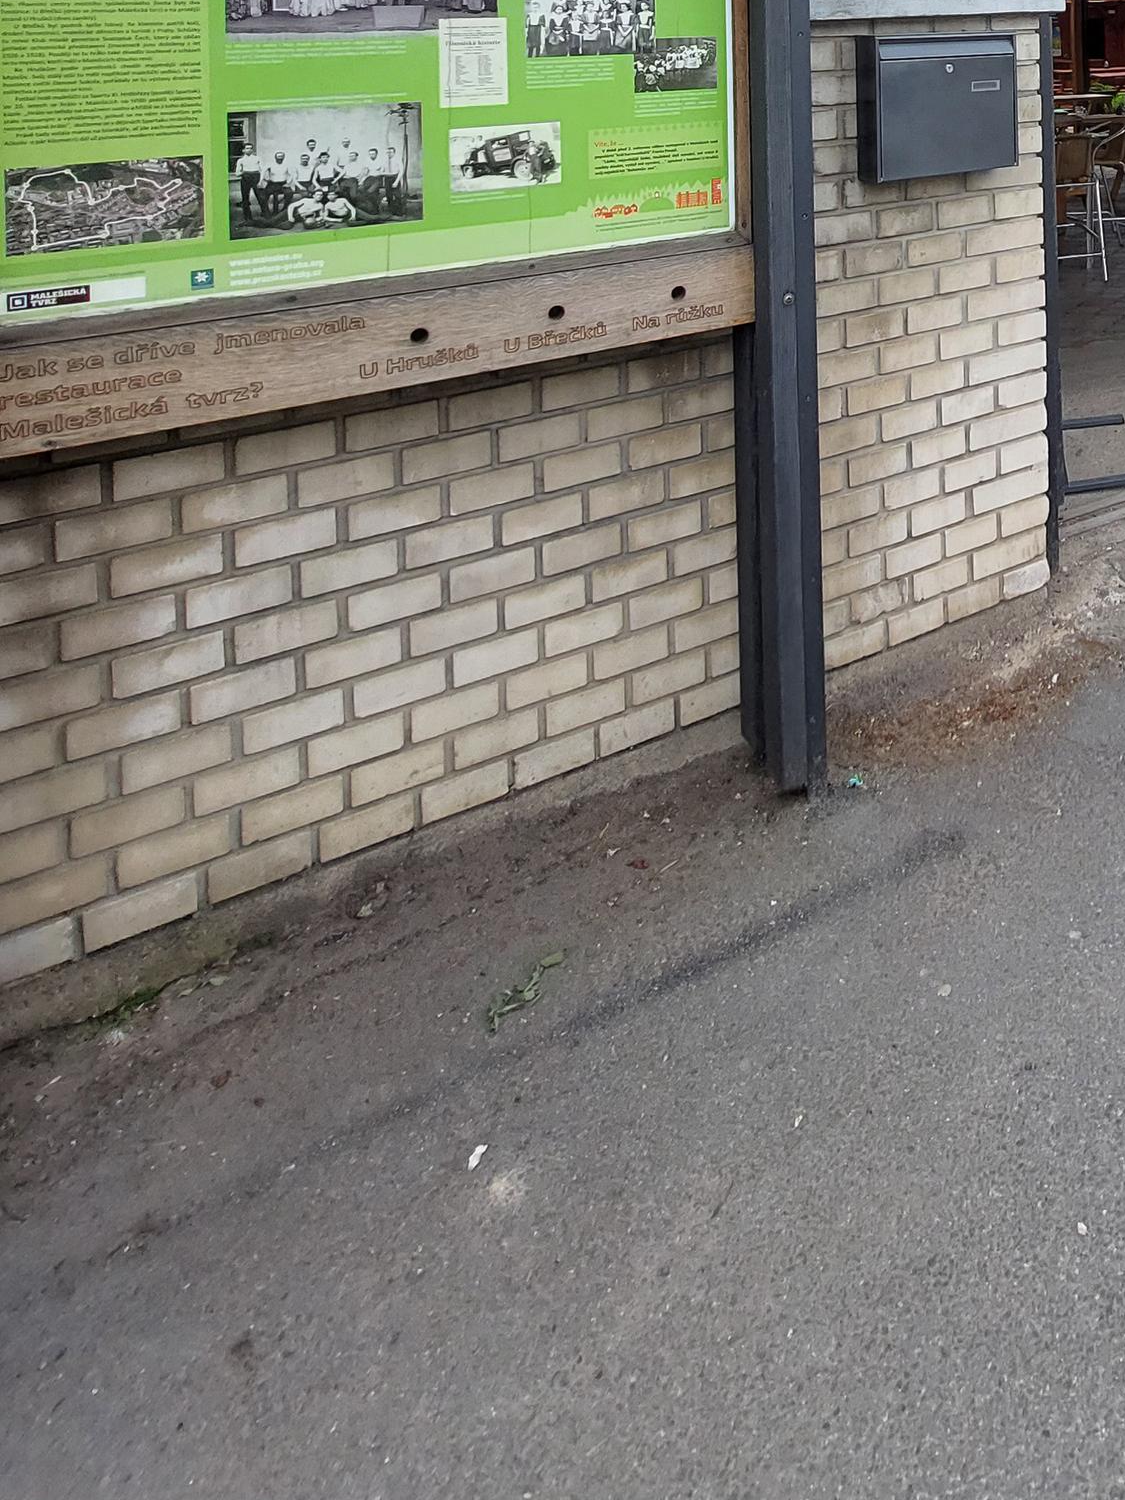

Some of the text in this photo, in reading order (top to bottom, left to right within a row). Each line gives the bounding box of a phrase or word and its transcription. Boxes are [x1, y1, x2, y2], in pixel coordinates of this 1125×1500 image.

[632, 302, 725, 332] Na růžku
[0, 315, 366, 382] Jak se dříve jmenovala
[503, 321, 608, 354] U Břečků
[359, 344, 480, 380] U Hrušků
[0, 368, 183, 410] restaurace
[0, 381, 265, 443] Malešická tvrz?
